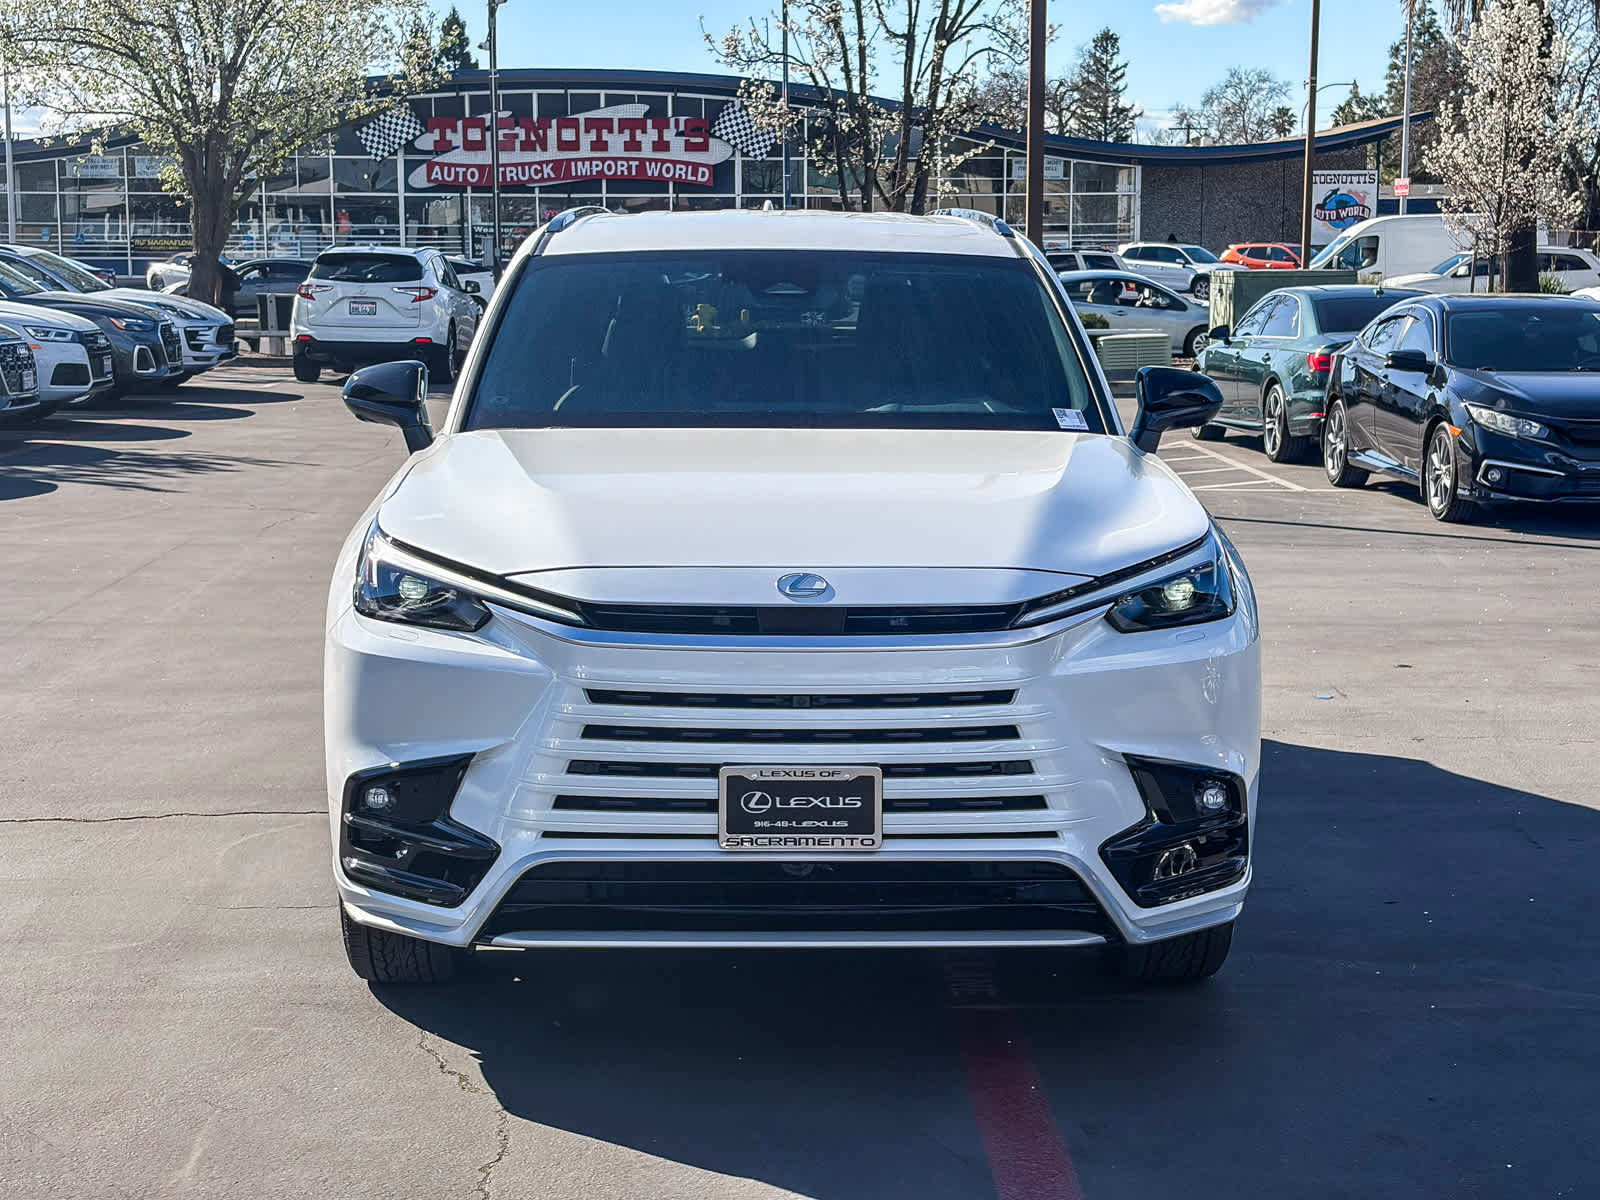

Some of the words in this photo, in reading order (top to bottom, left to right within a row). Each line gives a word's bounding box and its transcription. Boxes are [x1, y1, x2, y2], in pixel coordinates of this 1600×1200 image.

[428, 117, 710, 152] TOGNOTTI'S
[431, 165, 479, 182] AUTO
[499, 163, 556, 183] TRUCK
[570, 160, 640, 177] IMPORT
[645, 161, 710, 182] WORLD
[1313, 172, 1376, 185] TOGNOTTI'S
[1339, 206, 1371, 219] WORLD
[759, 770, 816, 778] LEXUS
[775, 796, 862, 808] LEXUS
[725, 836, 875, 847] SACRAMENTO
